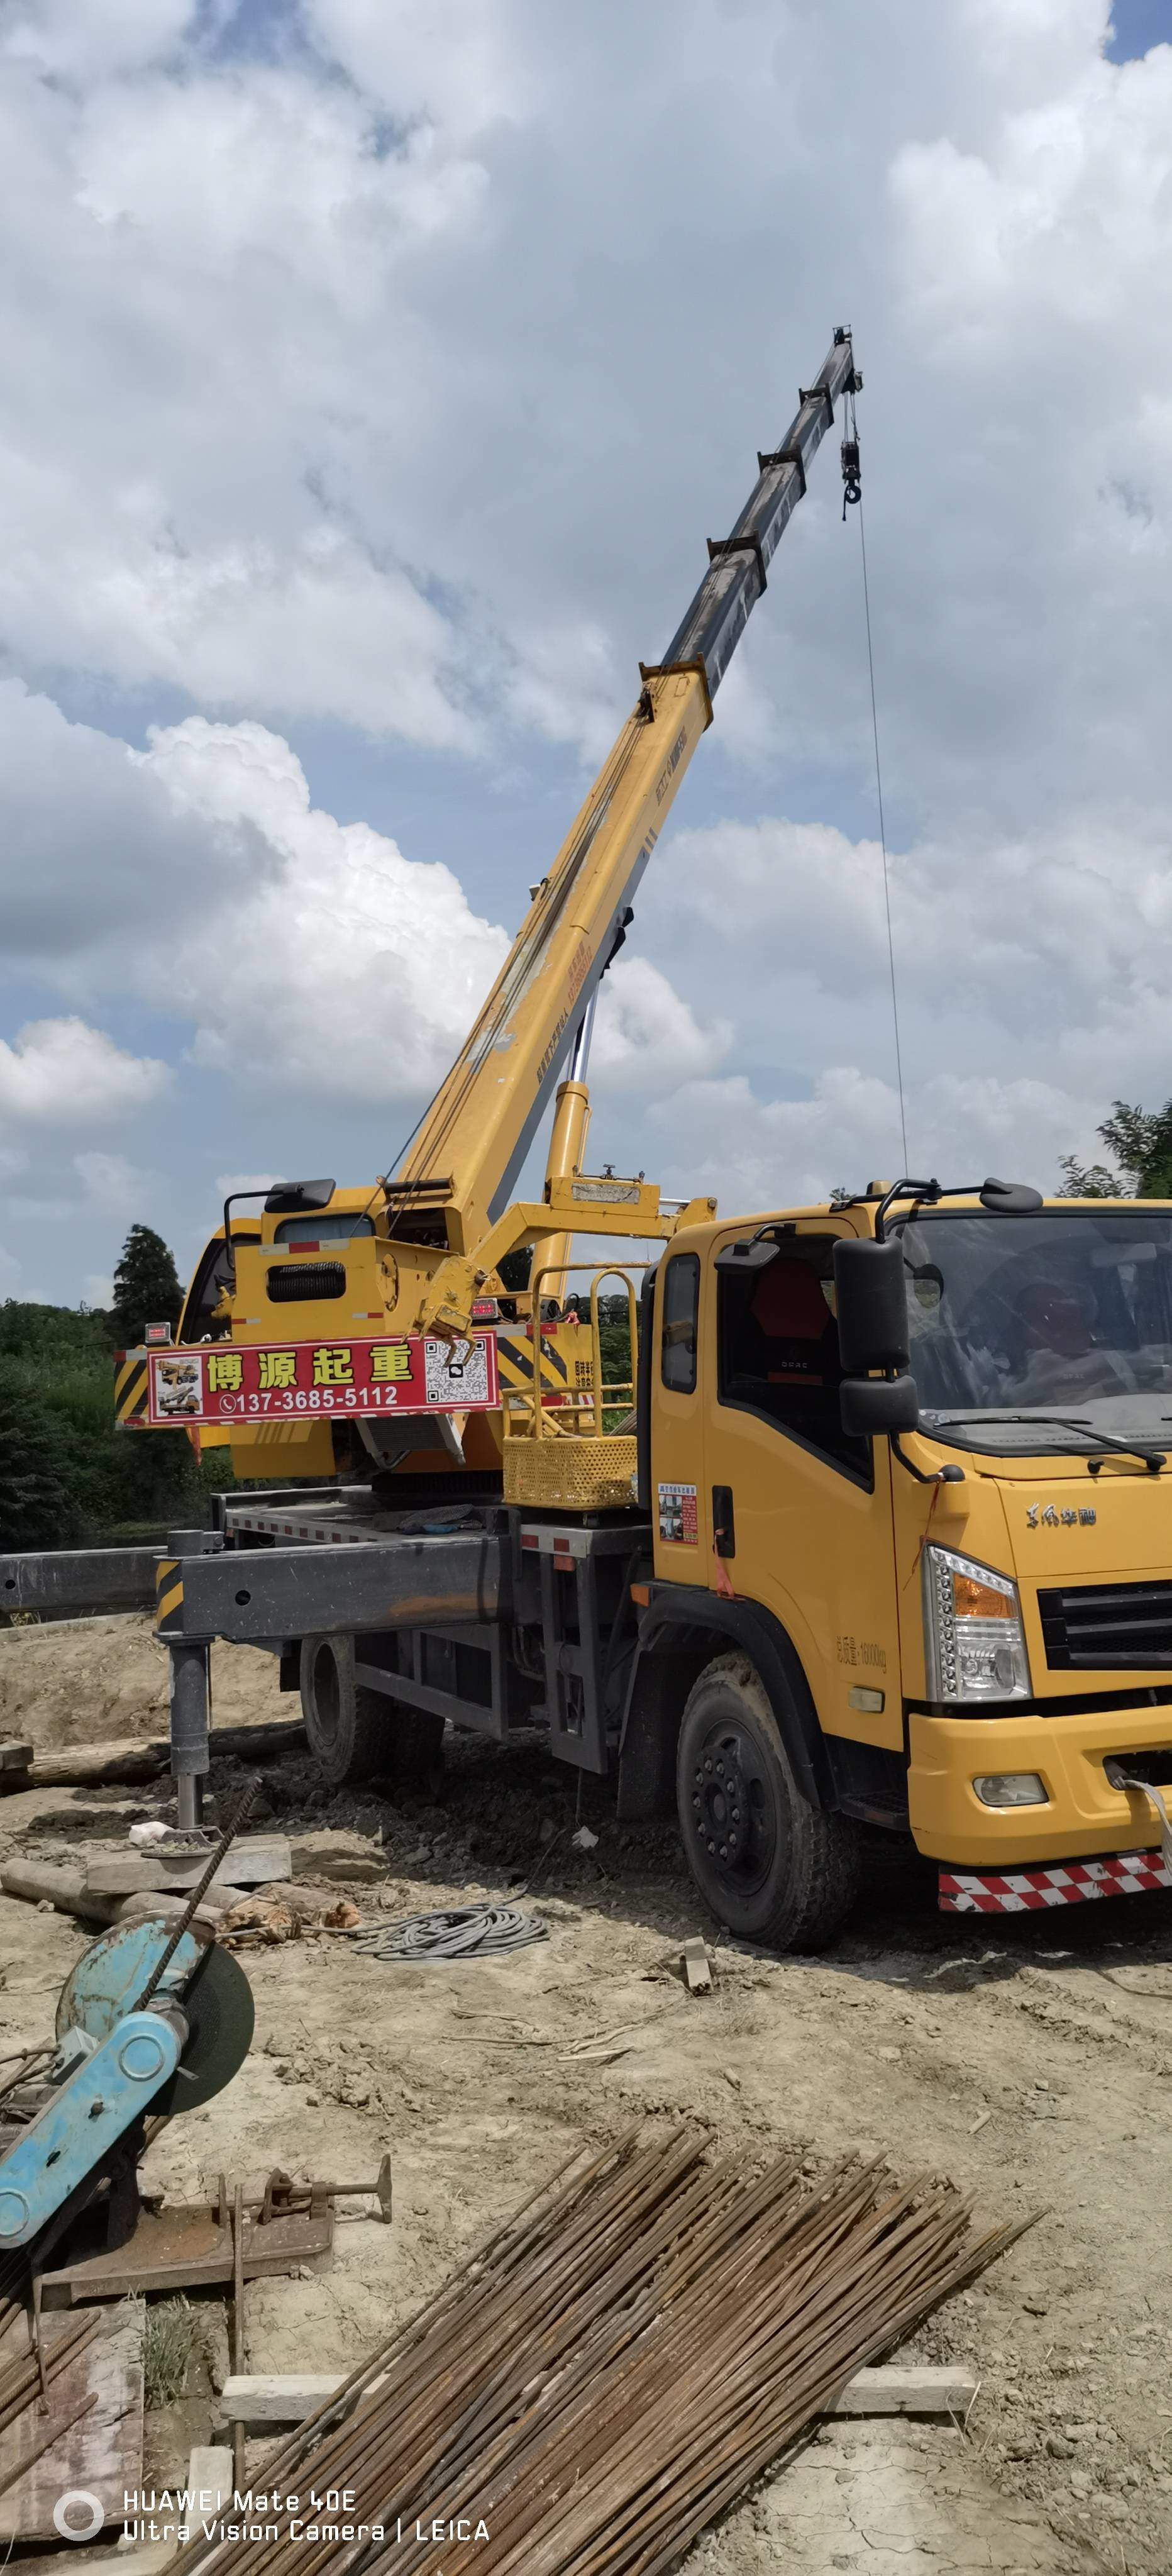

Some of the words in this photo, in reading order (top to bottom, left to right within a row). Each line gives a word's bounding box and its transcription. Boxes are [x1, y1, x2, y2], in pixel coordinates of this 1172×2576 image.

[207, 1343, 413, 1392] 博源起重
[236, 1385, 398, 1413] 137-3685-5112
